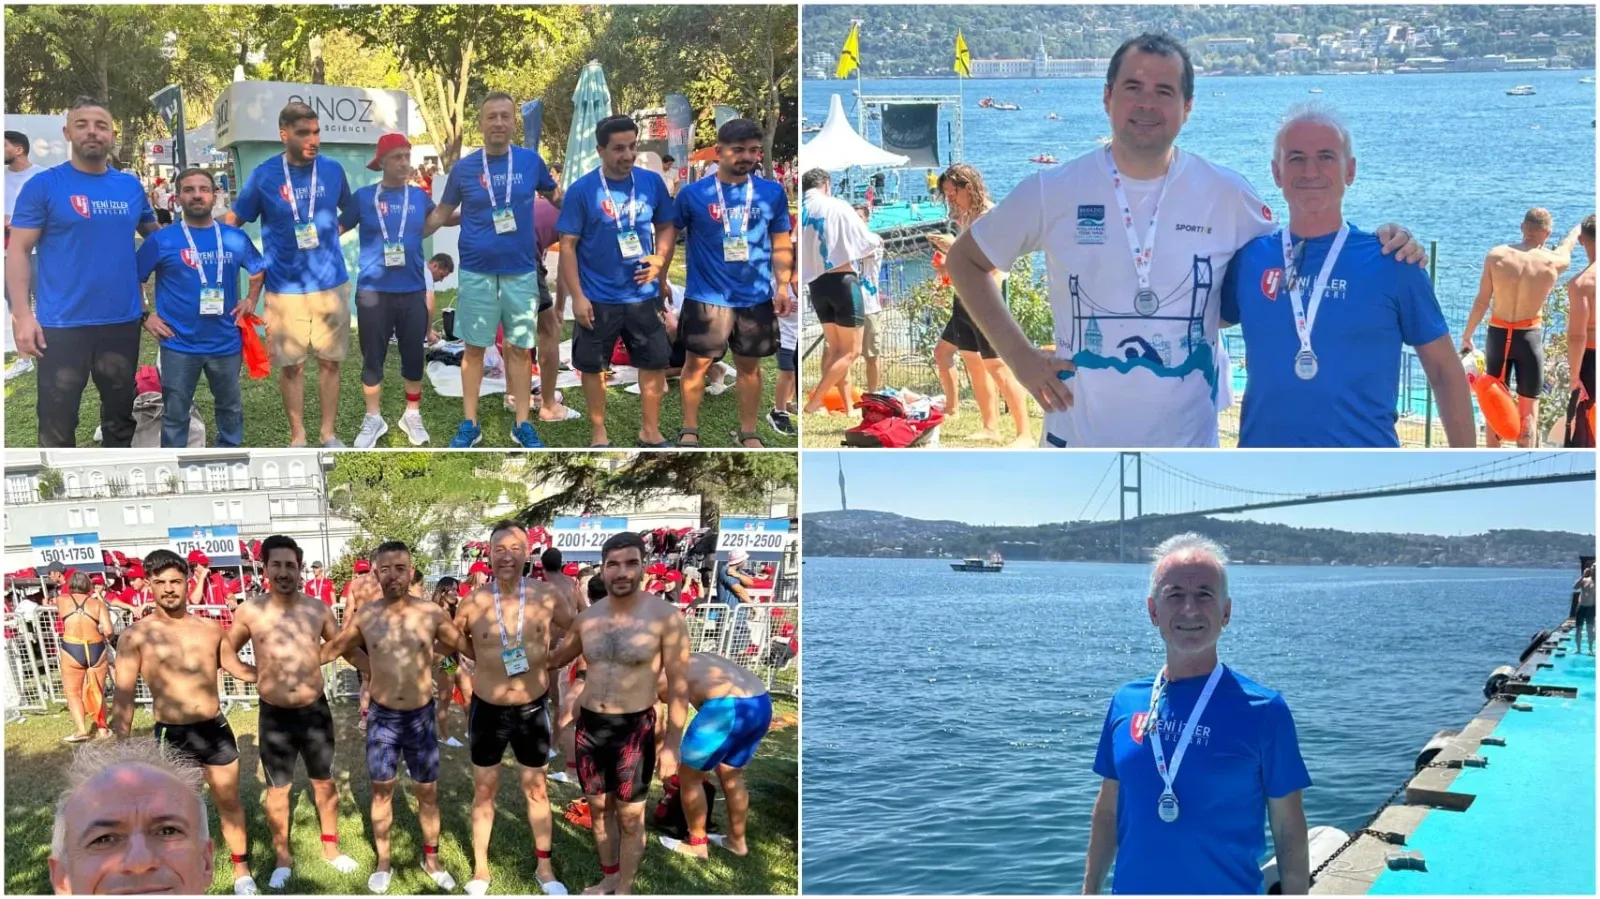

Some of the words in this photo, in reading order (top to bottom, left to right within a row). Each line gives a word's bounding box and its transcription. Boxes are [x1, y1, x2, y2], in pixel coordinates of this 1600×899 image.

[288, 95, 374, 123] NOZ
[324, 124, 367, 133] SCIENCE
[1175, 223, 1212, 234] SPORTIE
[1313, 275, 1347, 290] İER
[175, 539, 234, 555] 1751-2000
[557, 532, 614, 547] 2001-22
[722, 533, 782, 548] 2251-2500
[40, 546, 95, 563] 1501-1750
[1155, 718, 1177, 733] ENİ
[1178, 719, 1211, 737] İER
